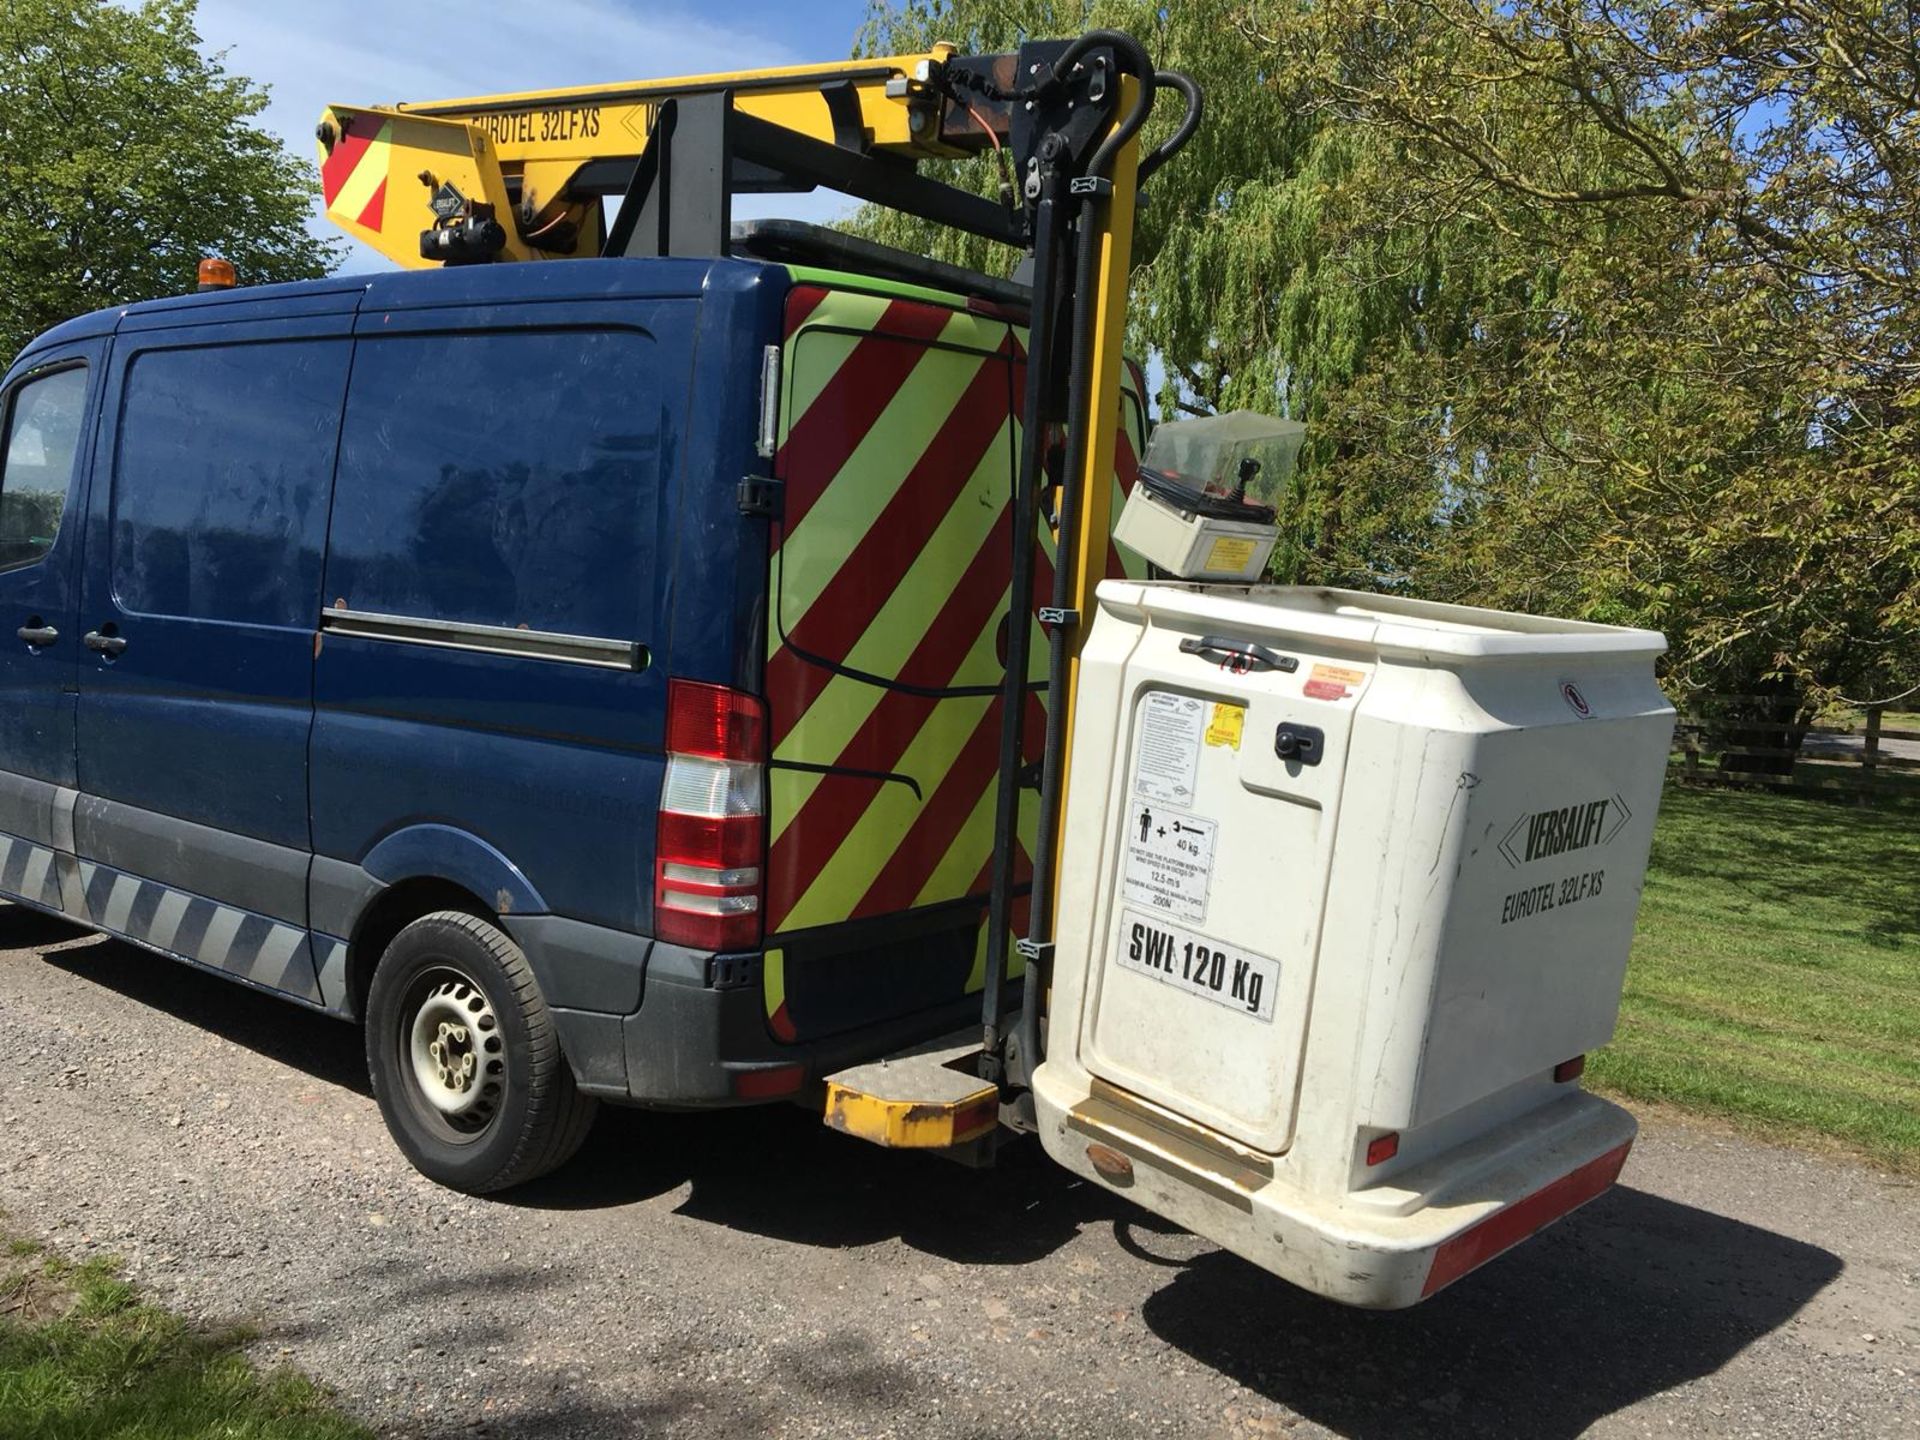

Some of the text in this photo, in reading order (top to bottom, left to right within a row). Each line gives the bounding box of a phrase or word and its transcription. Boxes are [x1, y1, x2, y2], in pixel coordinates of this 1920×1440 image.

[541, 107, 600, 141] 32LFXS
[1177, 839, 1187, 850] 40
[1525, 799, 1610, 862] VERSALIFT
[1151, 871, 1166, 884] 12.5
[1152, 894, 1172, 908] 200N
[1501, 882, 1555, 925] EUROTEL
[1130, 922, 1264, 1013] SWL 120 Kg
